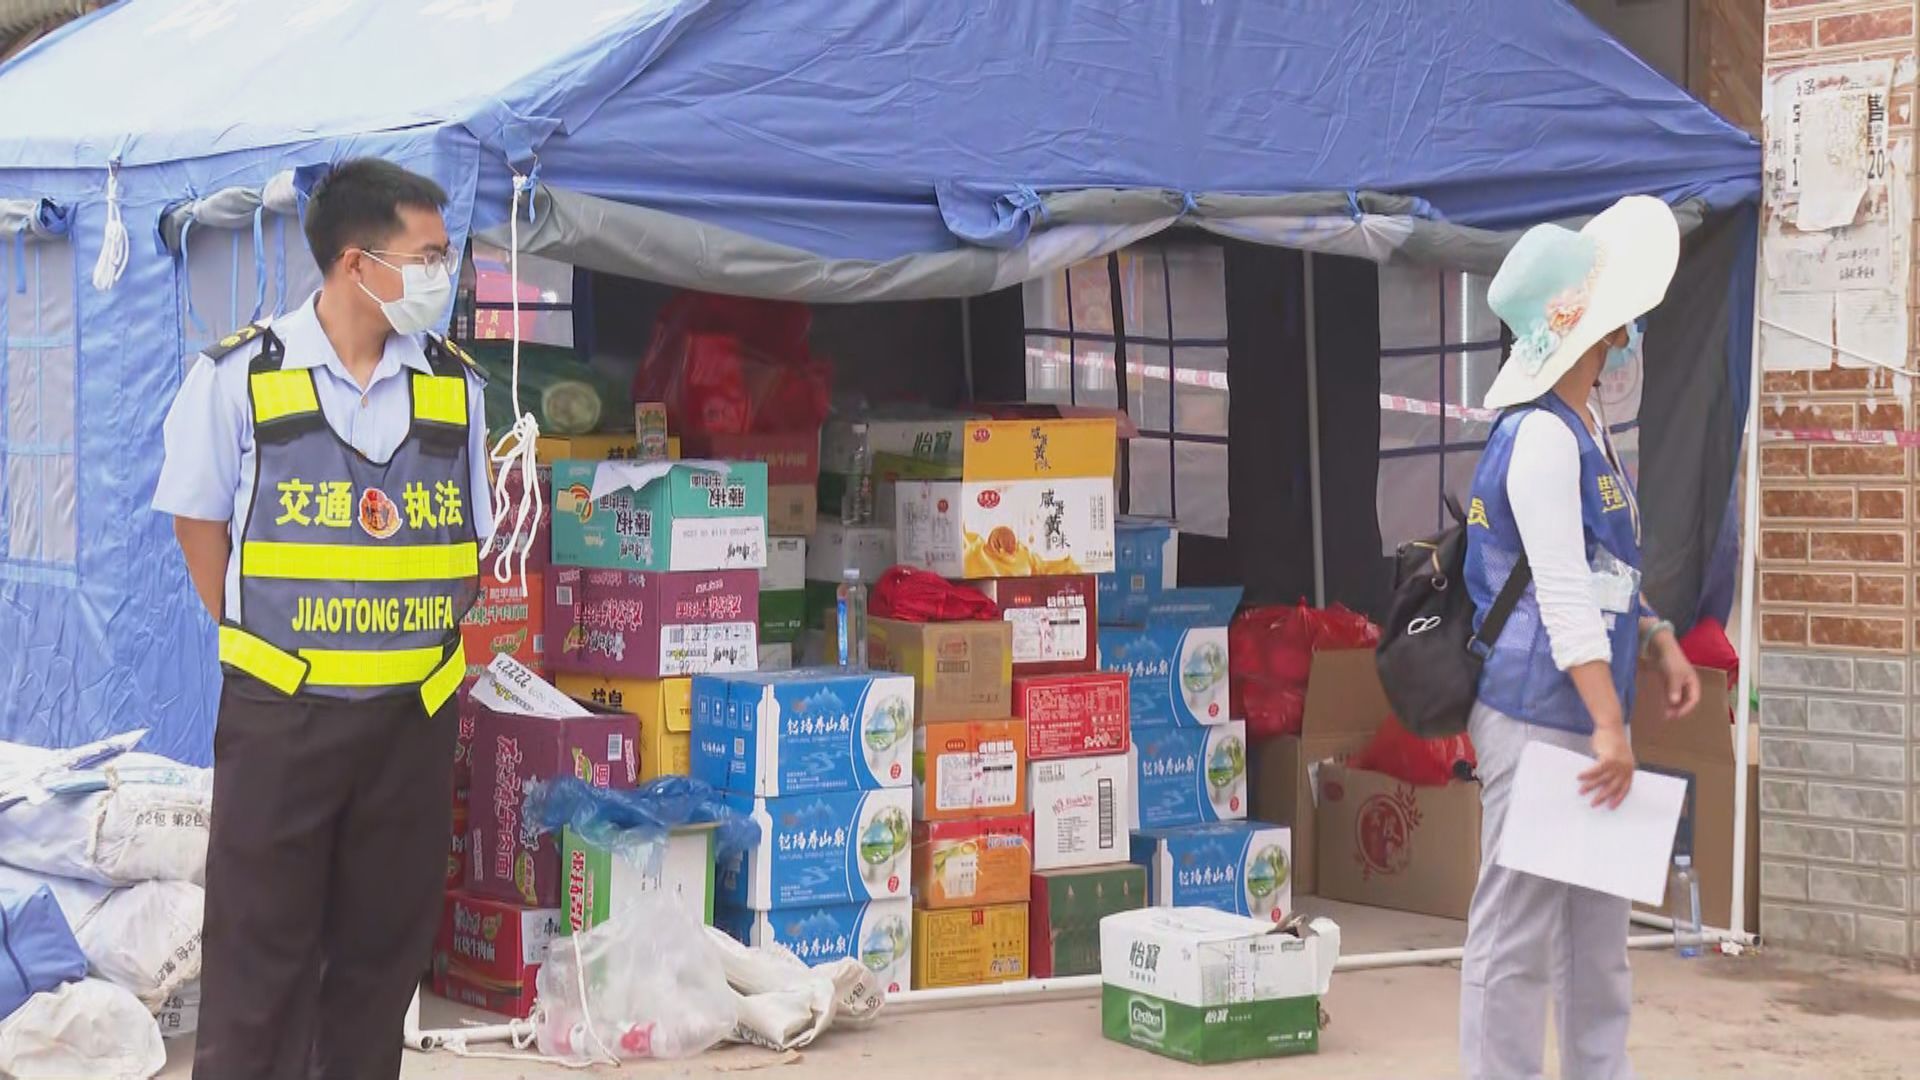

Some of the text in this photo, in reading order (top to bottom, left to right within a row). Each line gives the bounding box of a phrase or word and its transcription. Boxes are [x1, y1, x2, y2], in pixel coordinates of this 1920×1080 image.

[275, 478, 463, 528] 交通 执法
[708, 485, 746, 509] 藤椒
[615, 510, 652, 537] 藤椒
[292, 596, 454, 632] JIAOTONG ZHIFA
